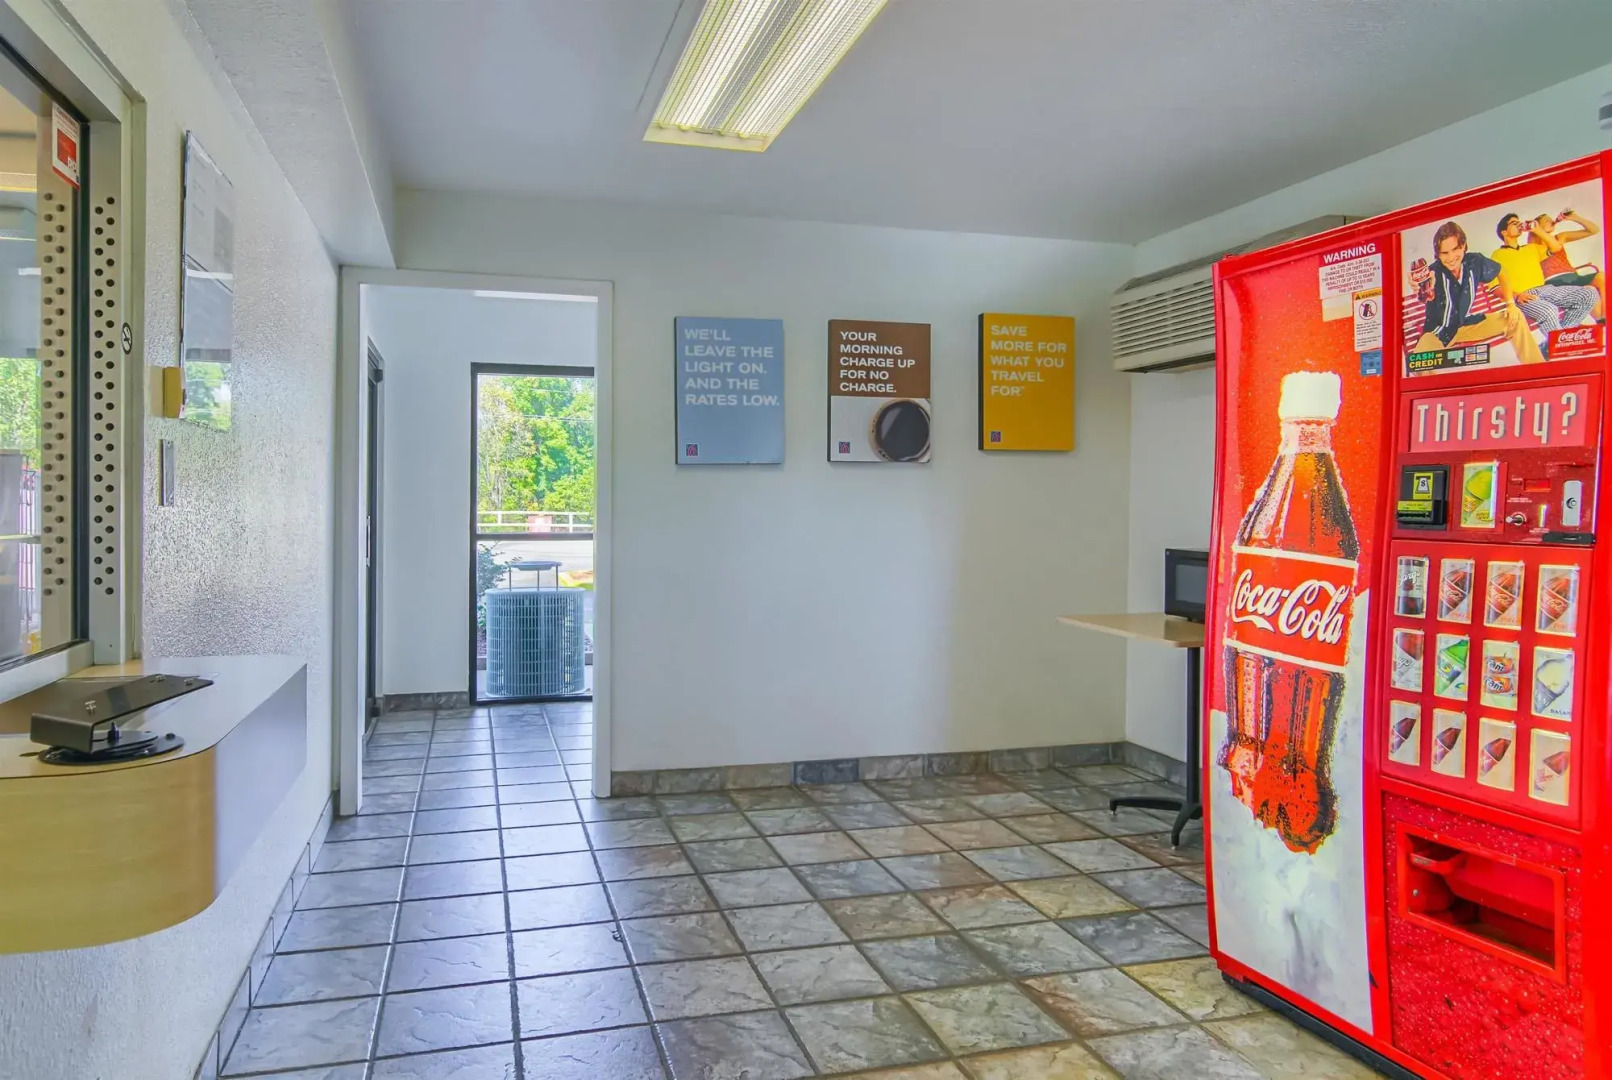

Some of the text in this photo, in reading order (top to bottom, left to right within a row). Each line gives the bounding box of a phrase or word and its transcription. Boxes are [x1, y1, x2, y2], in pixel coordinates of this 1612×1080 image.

[1323, 243, 1376, 264] WARNING
[685, 329, 730, 340] WE'LL
[991, 325, 1027, 336] SAVE
[1558, 328, 1593, 343] Coca-Cola
[840, 332, 876, 341] YOUR
[685, 346, 773, 358] LEAVE THE
[840, 345, 903, 355] MORNING
[991, 341, 1066, 352] MORE FOR
[991, 356, 1064, 367] WHAT YOU
[1409, 352, 1434, 361] CASH
[685, 362, 767, 374] LIGHT ON.
[840, 357, 915, 368] CHARGE UP
[1409, 358, 1443, 368] CREDIT
[840, 370, 889, 380] FOR NO
[992, 371, 1044, 382] TRAVEL
[685, 378, 759, 389] AND THE
[840, 383, 896, 392] CHARGE.
[685, 395, 779, 406] RATES LOW.
[1417, 392, 1577, 444] Thirsty?
[1231, 568, 1350, 644] Coca-Cola
